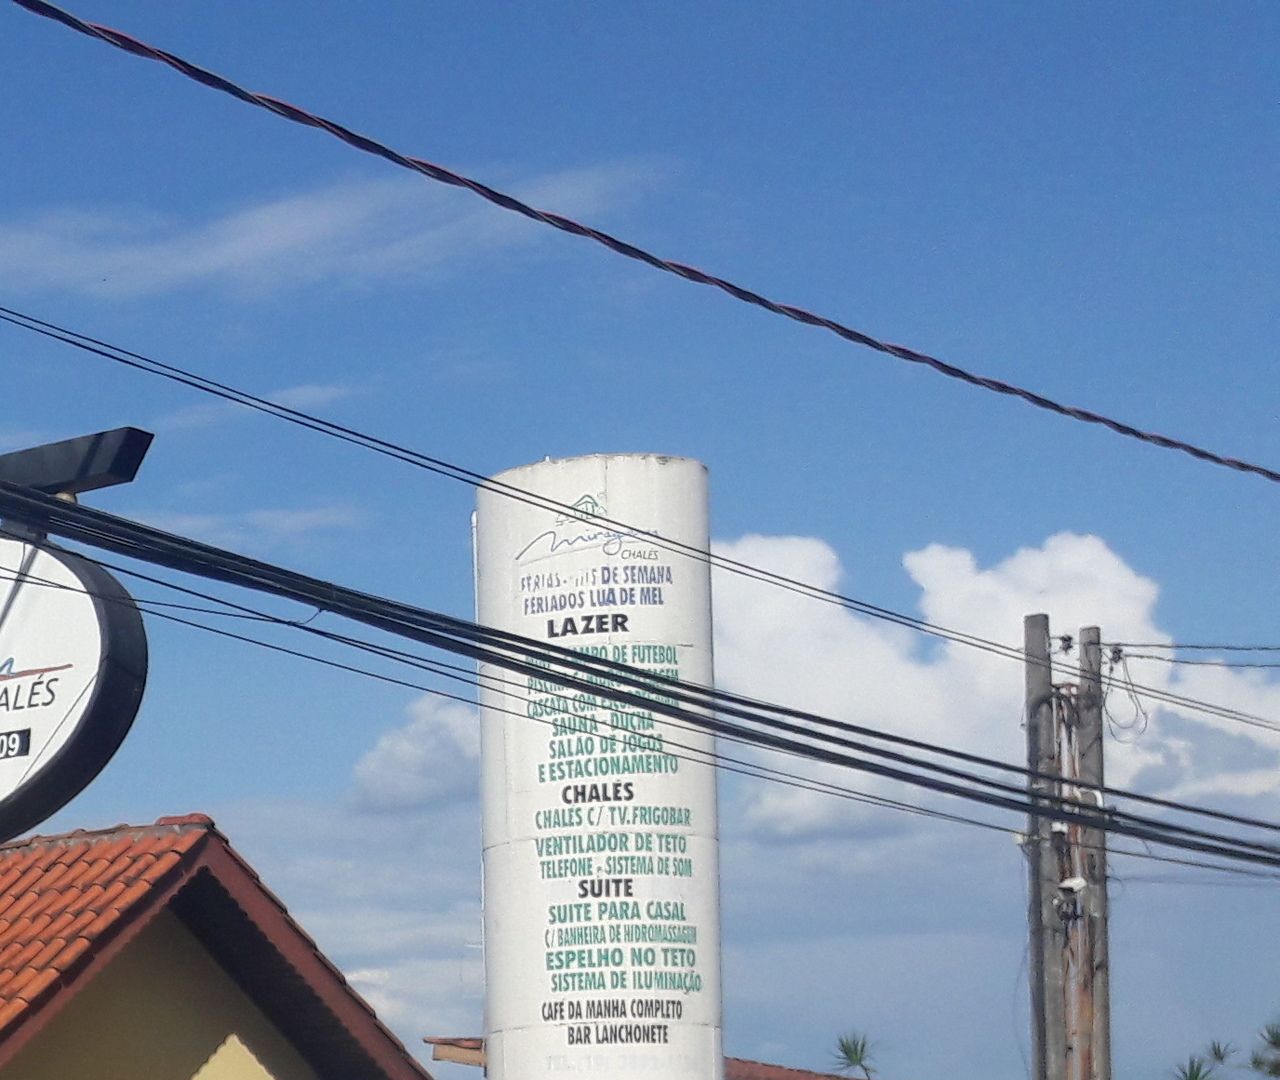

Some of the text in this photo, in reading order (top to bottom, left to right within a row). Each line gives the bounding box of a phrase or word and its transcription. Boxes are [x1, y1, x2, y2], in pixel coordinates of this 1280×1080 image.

[601, 566, 618, 585] DE
[524, 587, 664, 616] FERIADOS LUA DE MEL
[547, 613, 629, 638] LAZER
[612, 645, 627, 664] DE
[631, 644, 678, 665] FUTEBOL
[552, 714, 598, 737] SAUNA
[610, 711, 654, 731] DUCHA
[600, 735, 617, 753] DE
[622, 733, 663, 753] JOGOS
[538, 754, 679, 783] E ESTACIONAMENTO
[535, 833, 687, 857] VENTILADOR DE TETO
[540, 857, 593, 879] TELEFONE
[605, 856, 654, 876] SISTEMA
[657, 857, 670, 876] DE
[673, 858, 692, 877] SOM
[548, 900, 686, 924] SUITE PARA CASAL
[557, 925, 606, 947] BANHEIRA
[609, 924, 621, 943] DE
[545, 947, 696, 971] ESPELHO NO TETO
[551, 971, 606, 992] SISTEMA
[610, 970, 627, 990] DE
[568, 1000, 582, 1019] DA
[631, 998, 682, 1019] COMPLETO
[567, 1024, 669, 1045] BAR LANCHONETE
